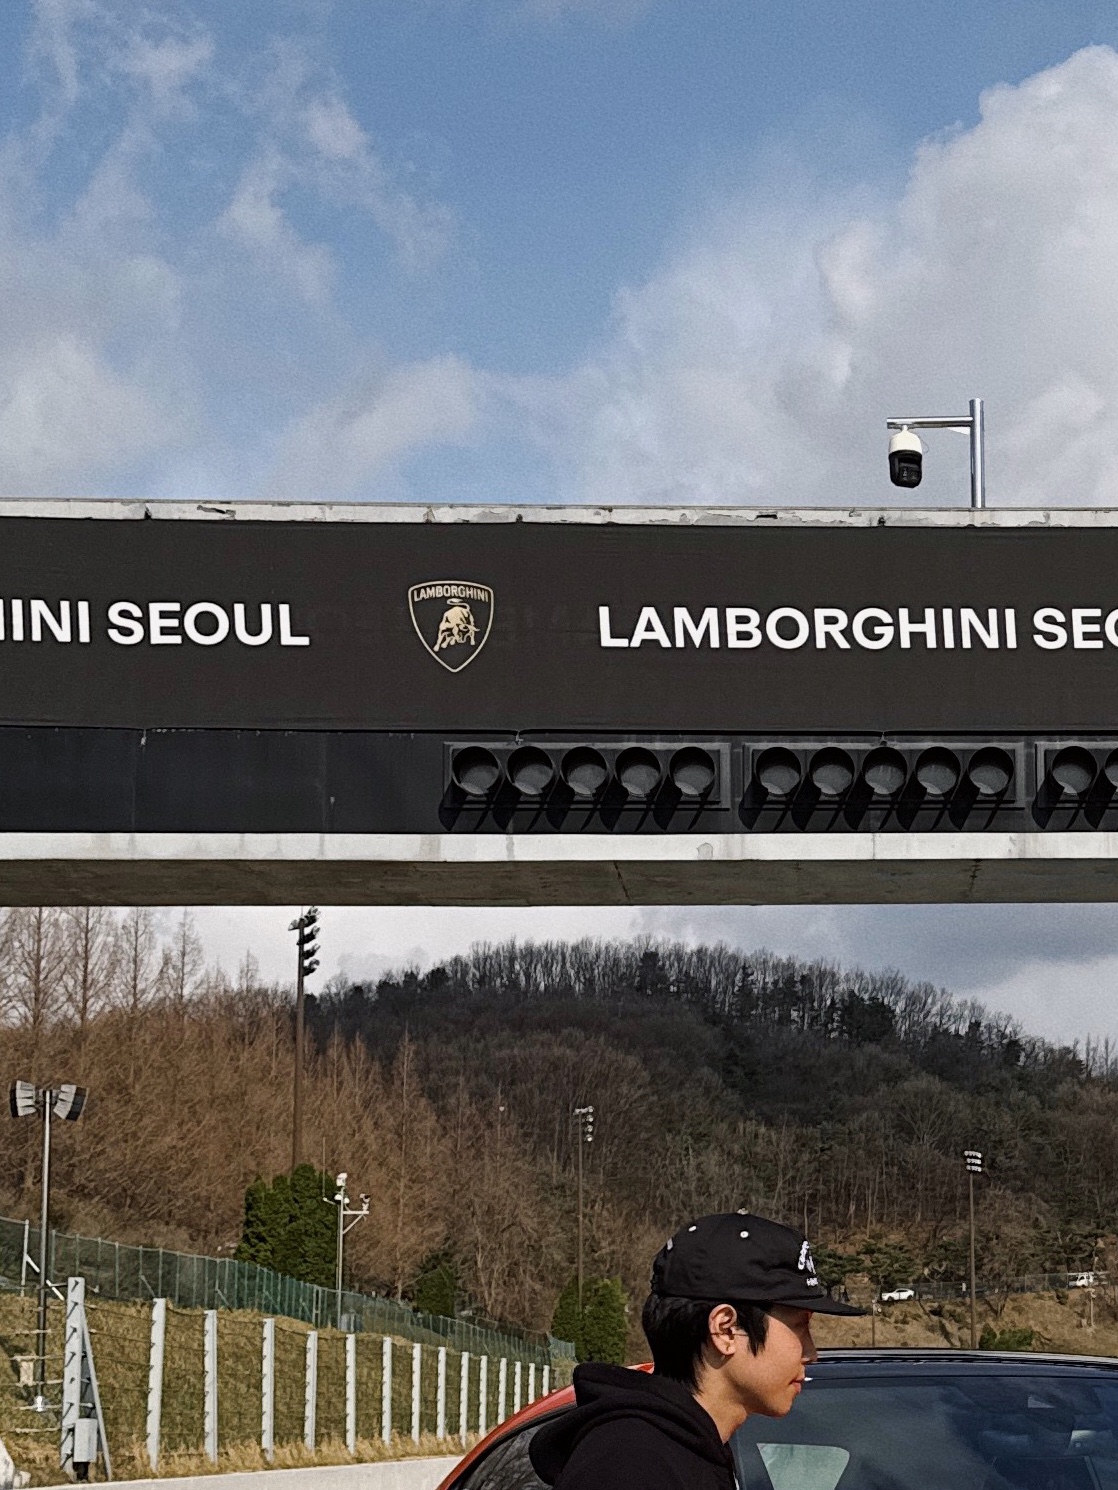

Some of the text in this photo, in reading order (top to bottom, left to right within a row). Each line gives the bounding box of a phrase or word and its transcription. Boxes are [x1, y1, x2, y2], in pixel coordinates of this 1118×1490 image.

[413, 585, 489, 603] LAMBORGHINI
[107, 601, 310, 646] SEOUL
[598, 606, 1017, 650] LAMBORGHINI
